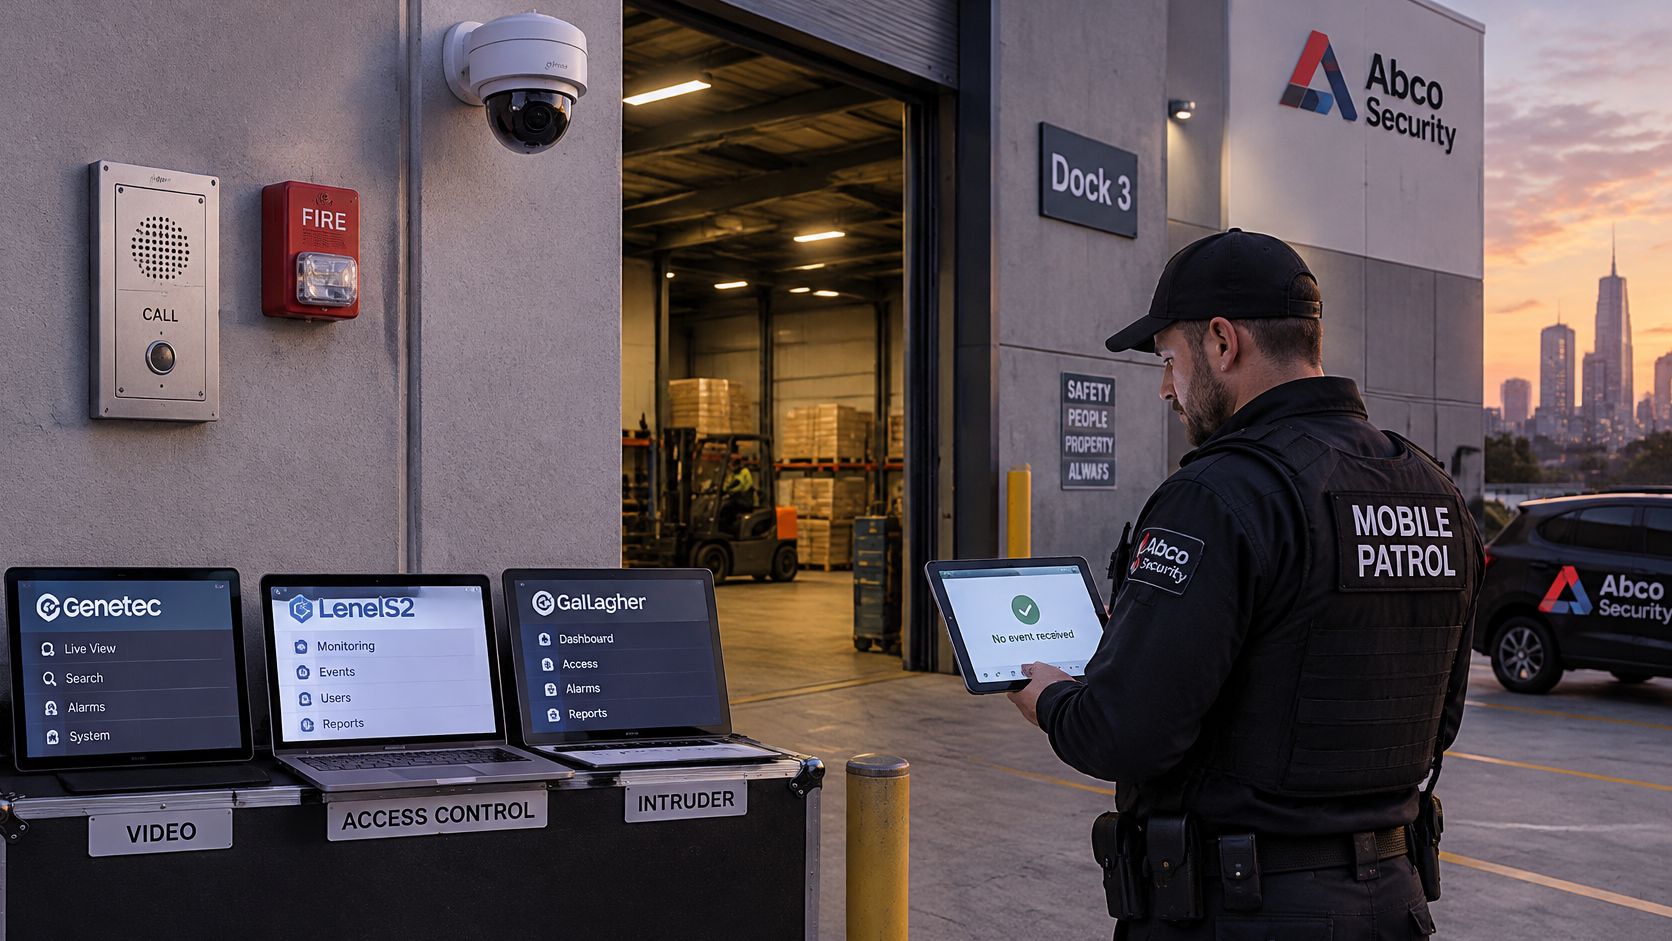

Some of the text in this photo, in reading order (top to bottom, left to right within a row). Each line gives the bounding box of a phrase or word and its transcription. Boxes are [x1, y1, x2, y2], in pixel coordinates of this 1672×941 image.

[1365, 52, 1444, 110] Abco
[1366, 97, 1457, 155] Security
[1051, 152, 1131, 211] Dock 3
[302, 207, 346, 231] FIRE
[142, 307, 179, 322] CALL
[1067, 379, 1111, 402] SAFETY
[1068, 408, 1108, 428] PEOPLE
[1065, 435, 1113, 454] PROPERTY
[1351, 504, 1453, 538] MOBILE
[1146, 537, 1189, 564] Abco
[1357, 544, 1456, 577] PATROL
[1600, 574, 1664, 600] Abco
[63, 596, 162, 618] Genetec
[319, 597, 415, 618] LenelS2
[1599, 599, 1672, 624] Security
[317, 640, 375, 653] Monitoring
[559, 633, 614, 644] Dashboard
[992, 630, 1075, 644] No event received
[64, 643, 117, 655] Live View
[319, 667, 356, 677] Events
[563, 659, 599, 669] Access
[65, 672, 104, 684] Search
[320, 692, 352, 703] Users
[566, 683, 601, 694] Alarms
[68, 702, 106, 713] Alarms
[568, 708, 608, 721] Reports
[323, 718, 365, 730] Reports
[69, 730, 110, 744] System
[638, 790, 735, 813] INTRUDER
[341, 801, 536, 831] ACCESS CONTROL
[126, 822, 197, 844] VIDEO
